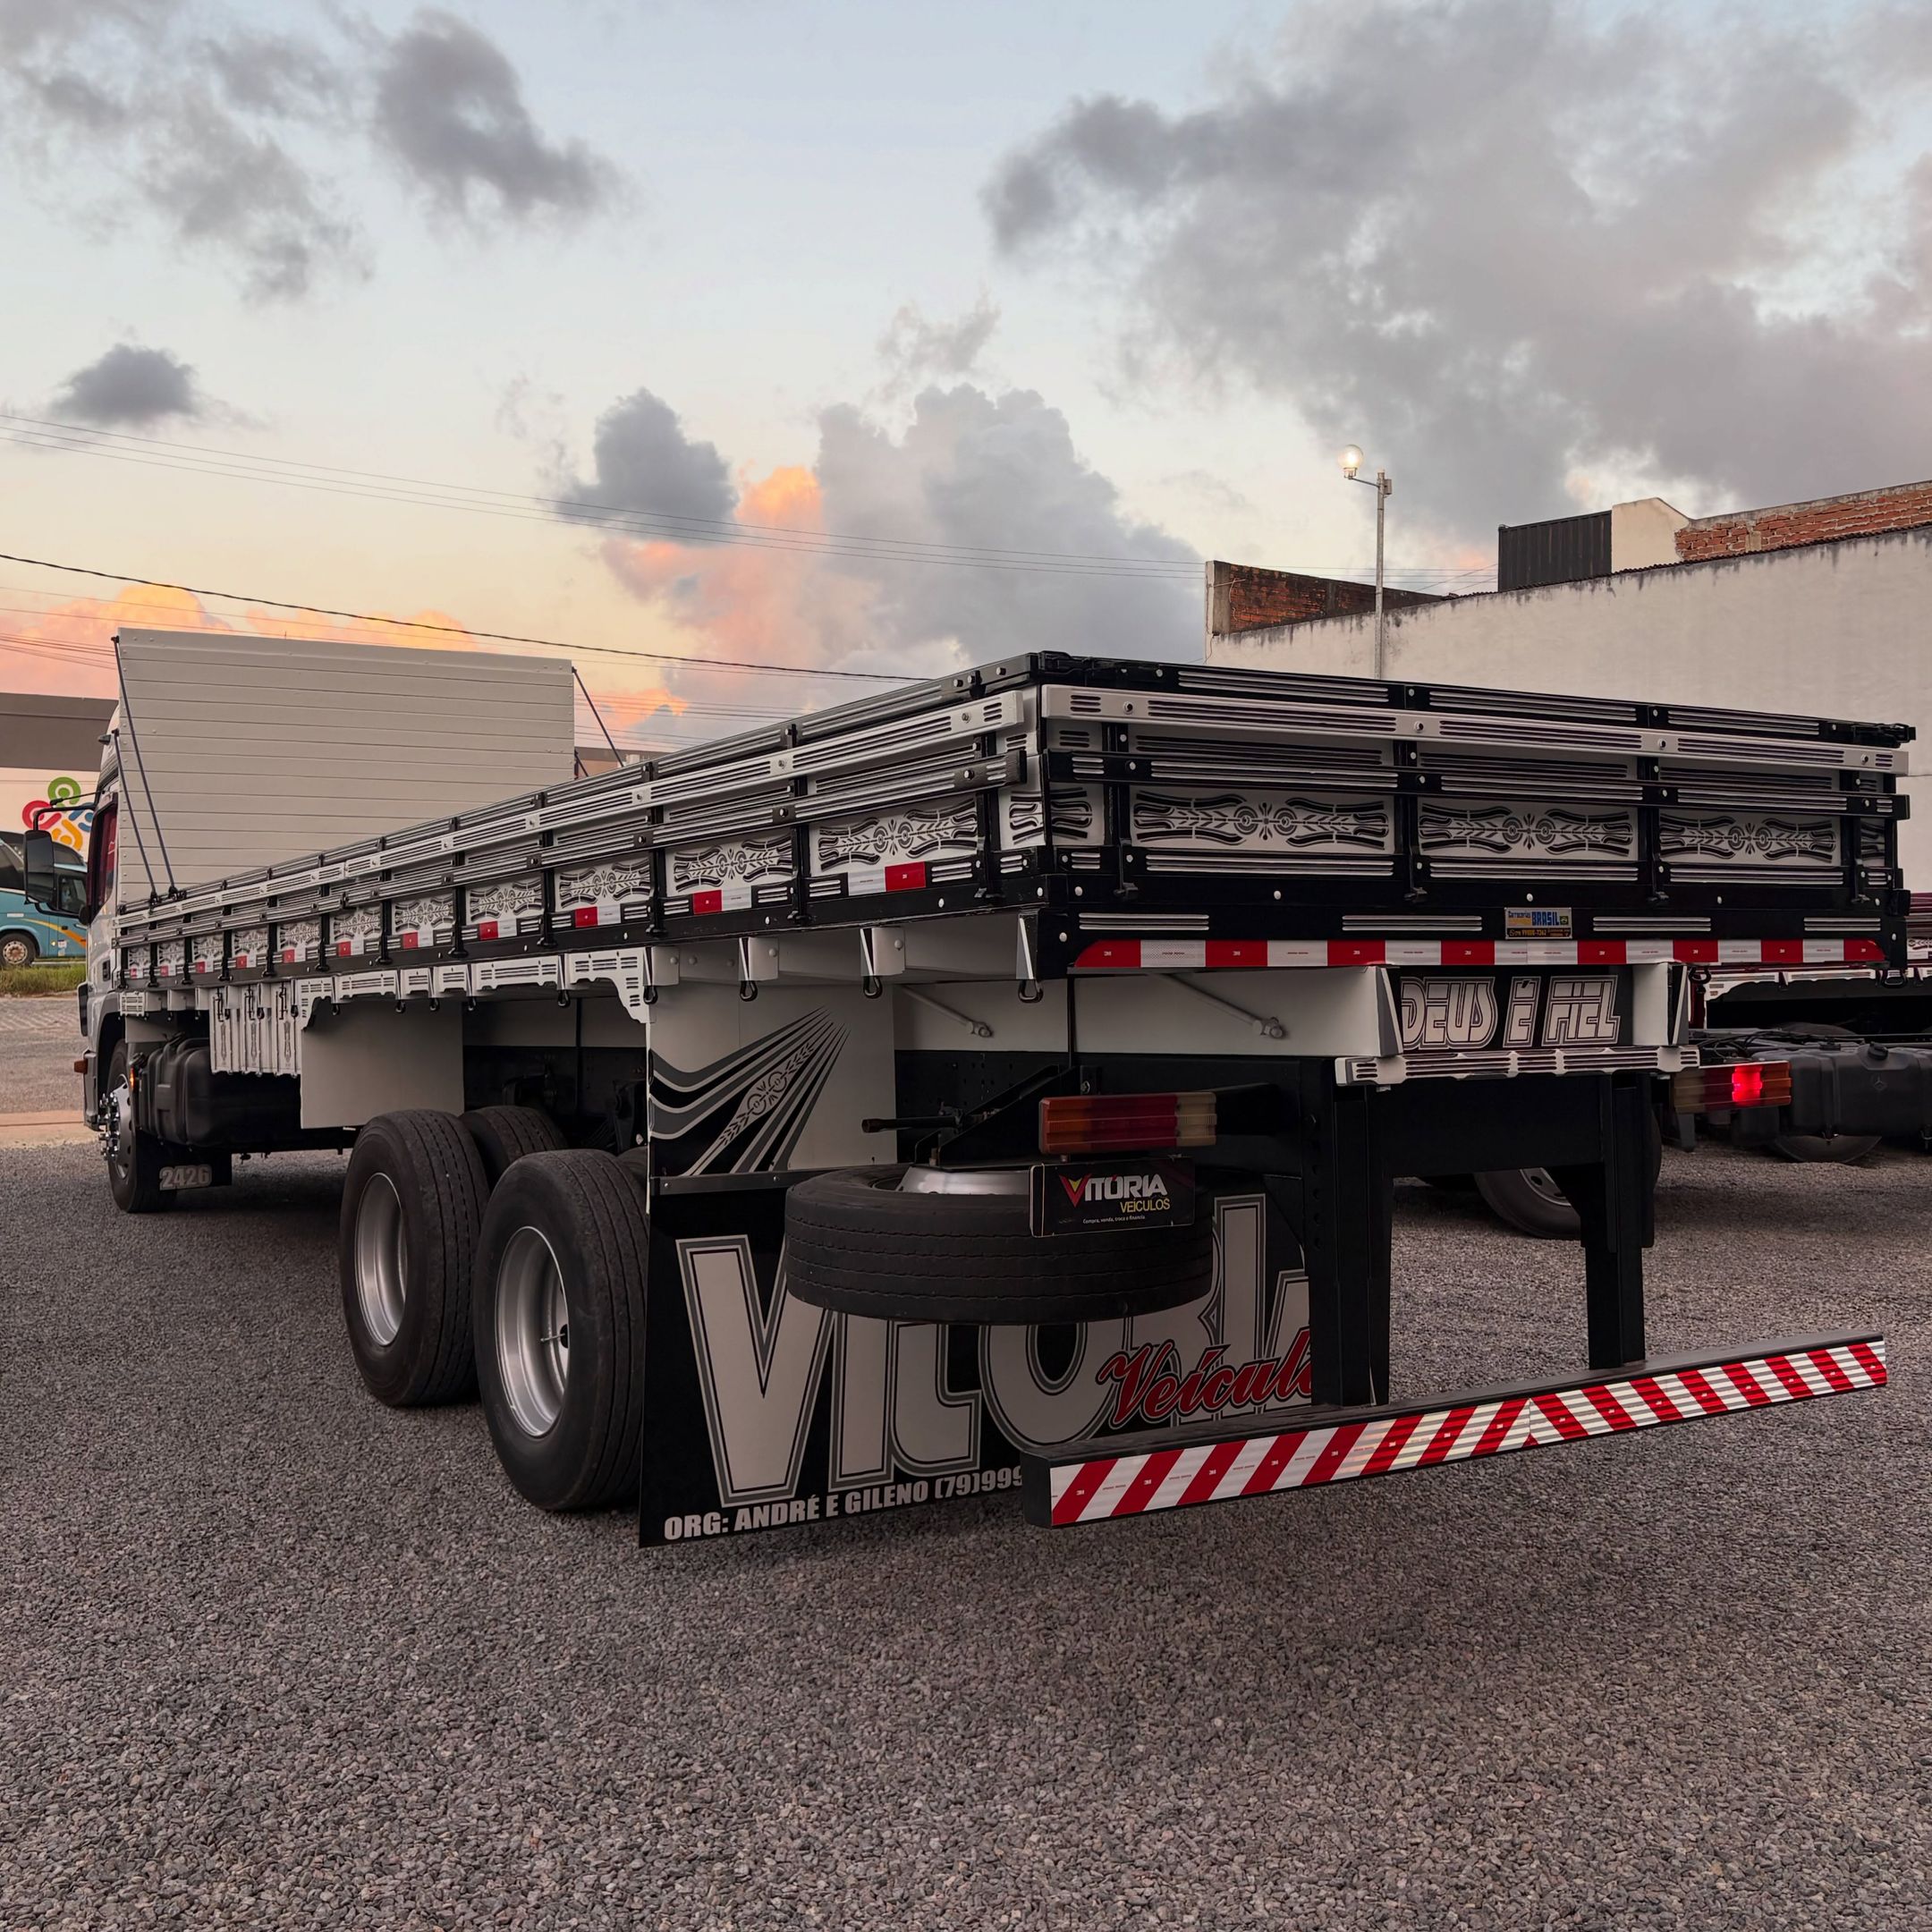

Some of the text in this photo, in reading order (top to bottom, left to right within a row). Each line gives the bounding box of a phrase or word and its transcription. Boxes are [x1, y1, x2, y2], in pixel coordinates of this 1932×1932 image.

[1532, 911, 1559, 926] BRASIL
[1401, 977, 1498, 1049] DEUS
[1541, 975, 1621, 1046] FIEL
[159, 1165, 212, 1191] 2426
[1120, 1198, 1170, 1214] VEÍCULOS
[1096, 1327, 1311, 1428] Veícul
[664, 1513, 729, 1540] ORG:
[734, 1495, 820, 1532] ANDRÉ
[826, 1498, 839, 1518] E
[845, 1479, 928, 1514] GILENO
